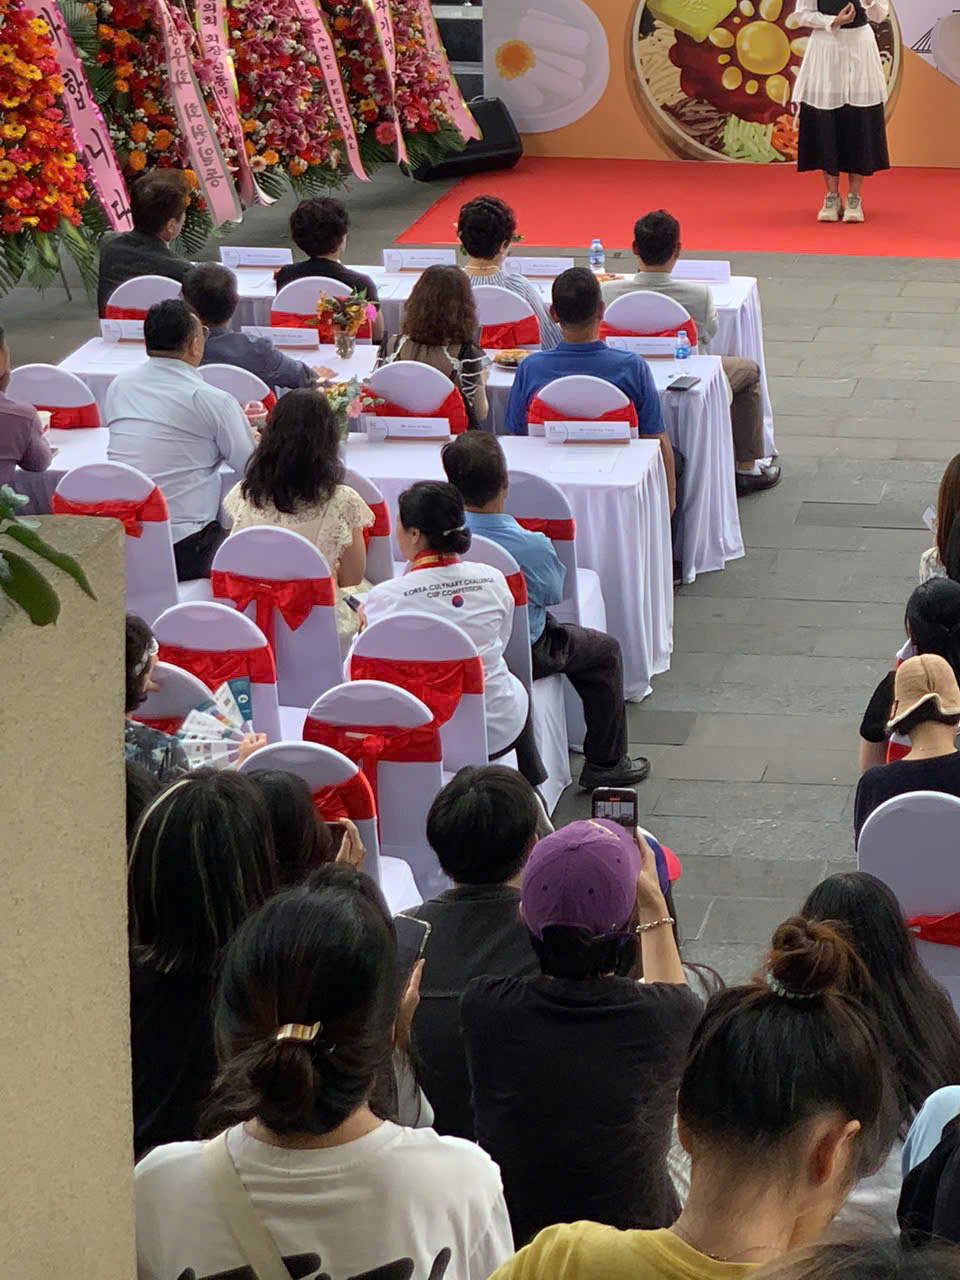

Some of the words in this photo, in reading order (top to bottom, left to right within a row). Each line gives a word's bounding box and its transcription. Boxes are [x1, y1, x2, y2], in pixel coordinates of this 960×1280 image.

[329, 78, 356, 150] FESTIVAL
[404, 586, 428, 597] KOREA
[426, 591, 441, 599] CUP
[441, 585, 483, 597] COMPETITION
